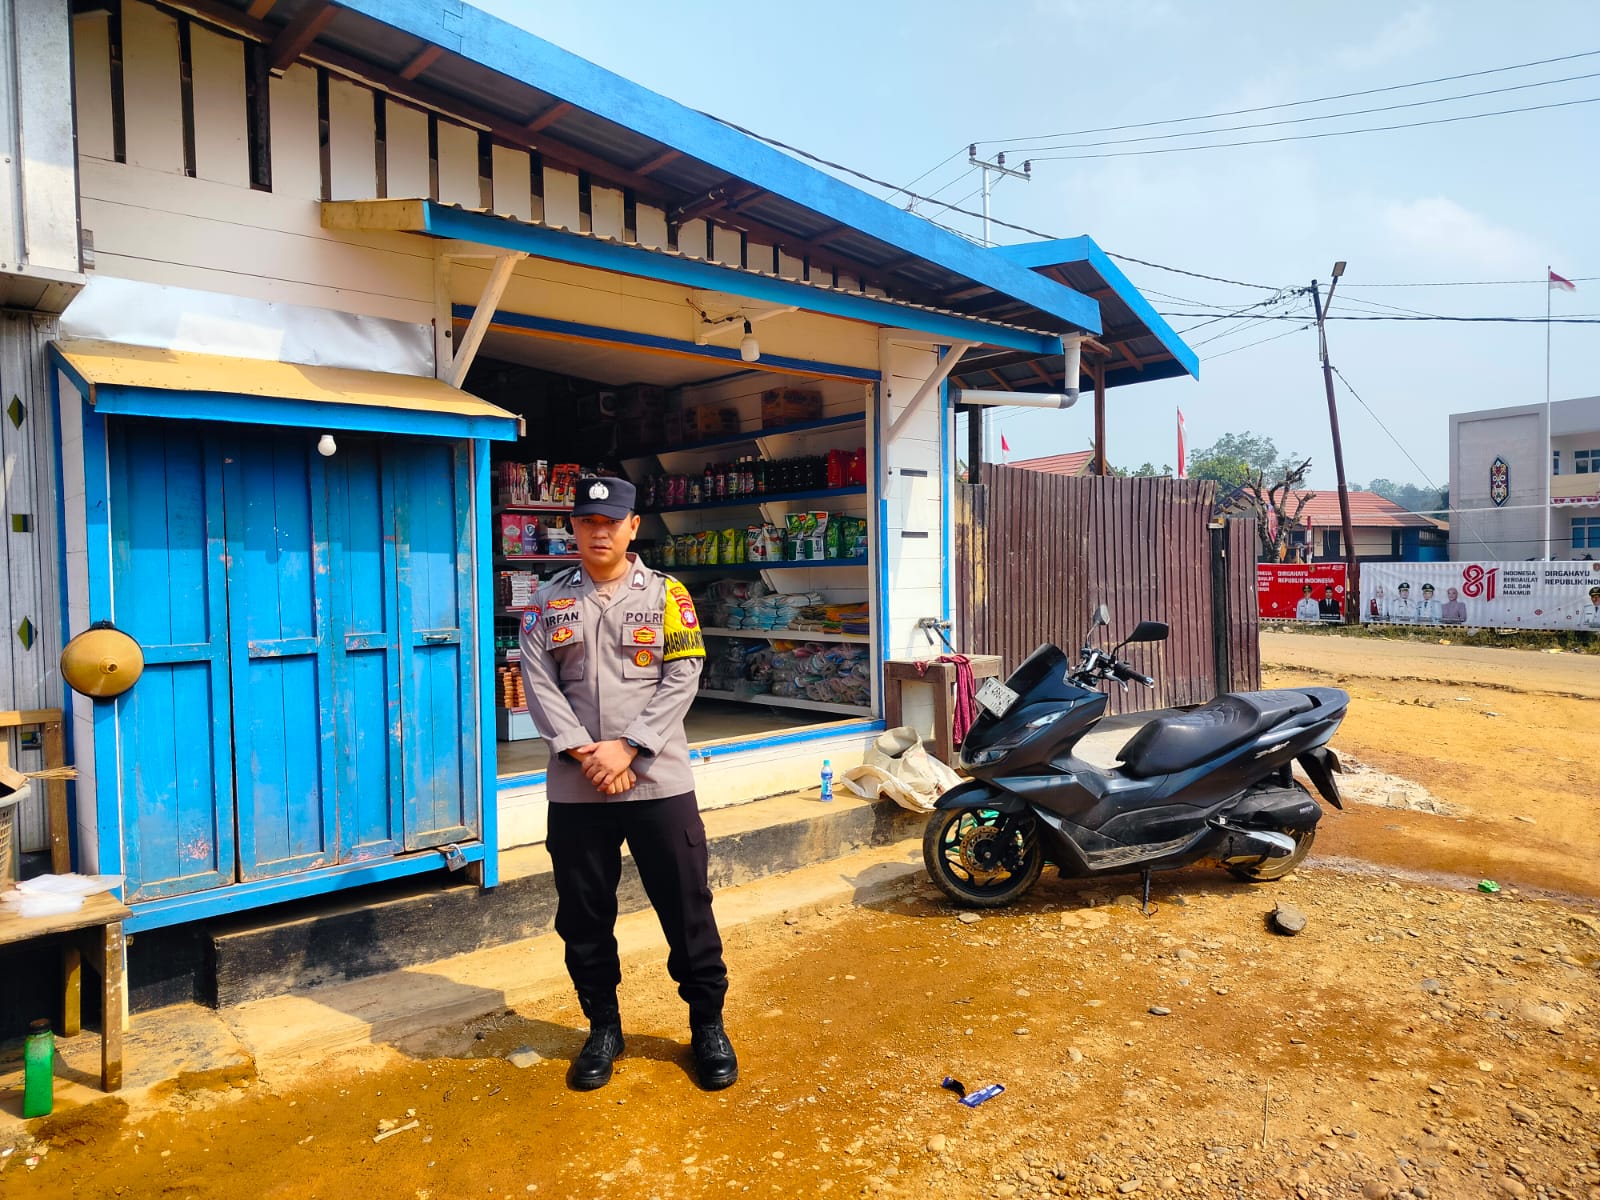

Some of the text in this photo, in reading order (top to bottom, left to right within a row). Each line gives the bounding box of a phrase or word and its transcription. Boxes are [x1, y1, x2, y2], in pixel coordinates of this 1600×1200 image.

[1462, 564, 1500, 602] 81
[1545, 578, 1583, 586] REPUBLIK
[545, 611, 579, 627] IRFAN
[625, 612, 663, 623] POLRI
